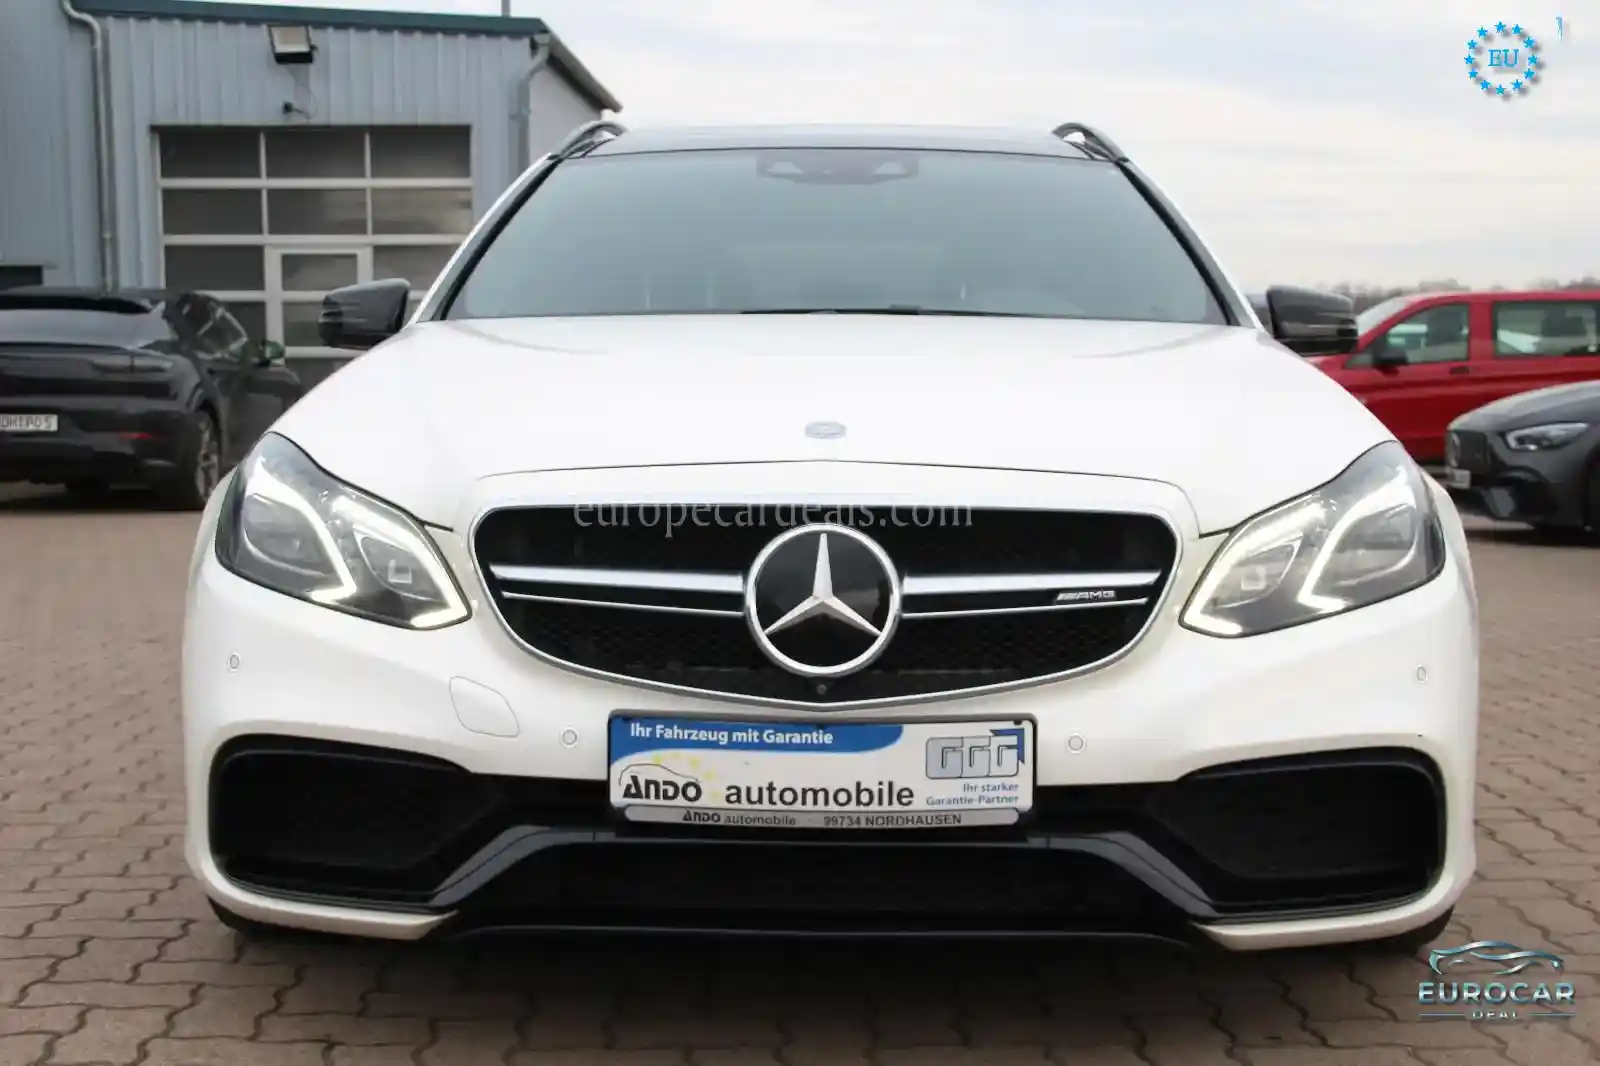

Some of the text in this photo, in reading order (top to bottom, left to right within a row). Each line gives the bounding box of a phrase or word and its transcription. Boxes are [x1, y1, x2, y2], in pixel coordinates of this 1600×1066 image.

[630, 723, 834, 745] Ihr Fahrzeug mit Garantie
[963, 782, 1019, 792] Ihr starker
[725, 780, 914, 807] automobile
[724, 814, 796, 826] automobile
[823, 814, 962, 826] 99734 NORDHAUSEN
